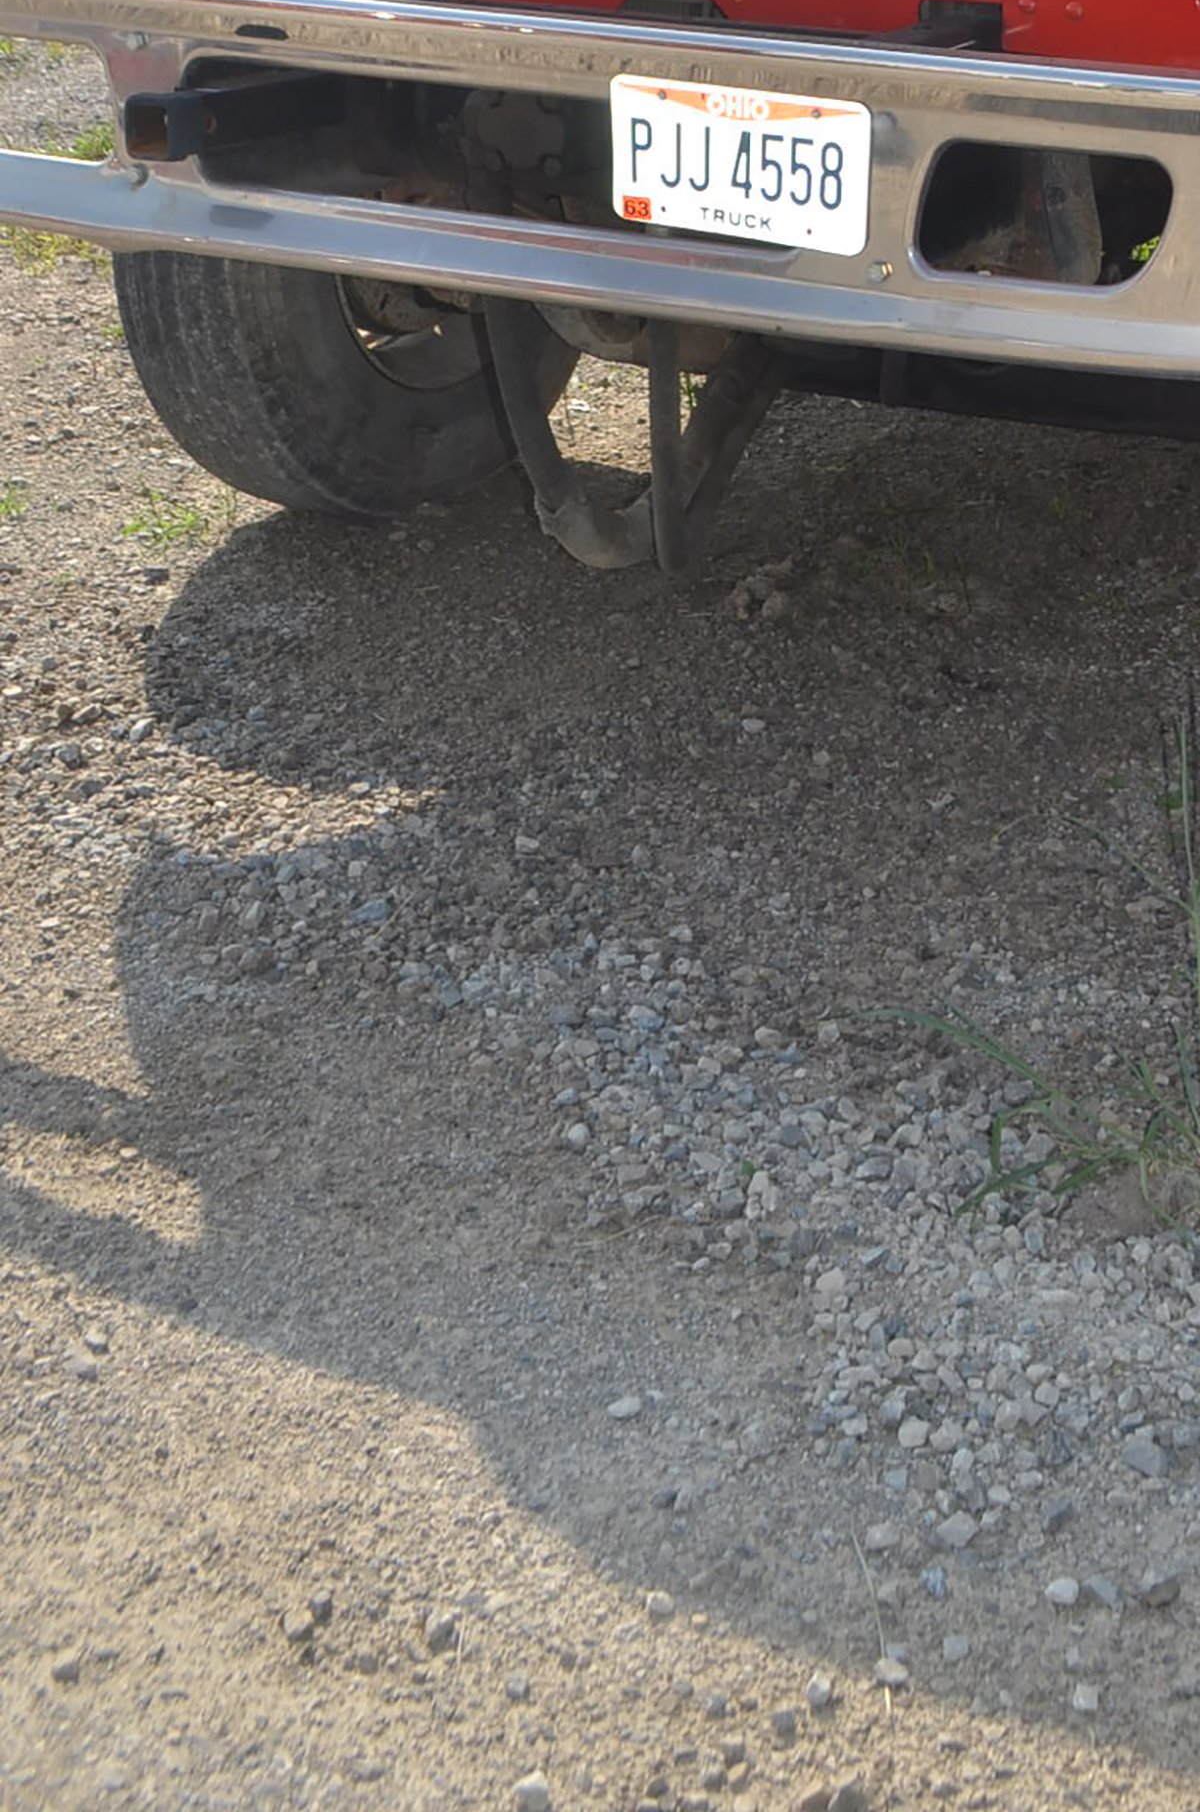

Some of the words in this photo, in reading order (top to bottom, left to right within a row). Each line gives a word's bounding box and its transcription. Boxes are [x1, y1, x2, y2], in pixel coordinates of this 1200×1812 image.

[705, 92, 770, 120] OHIO
[630, 117, 711, 192] PJJ
[731, 130, 844, 211] 4558
[624, 199, 650, 217] 63
[700, 207, 773, 230] TRUCK
